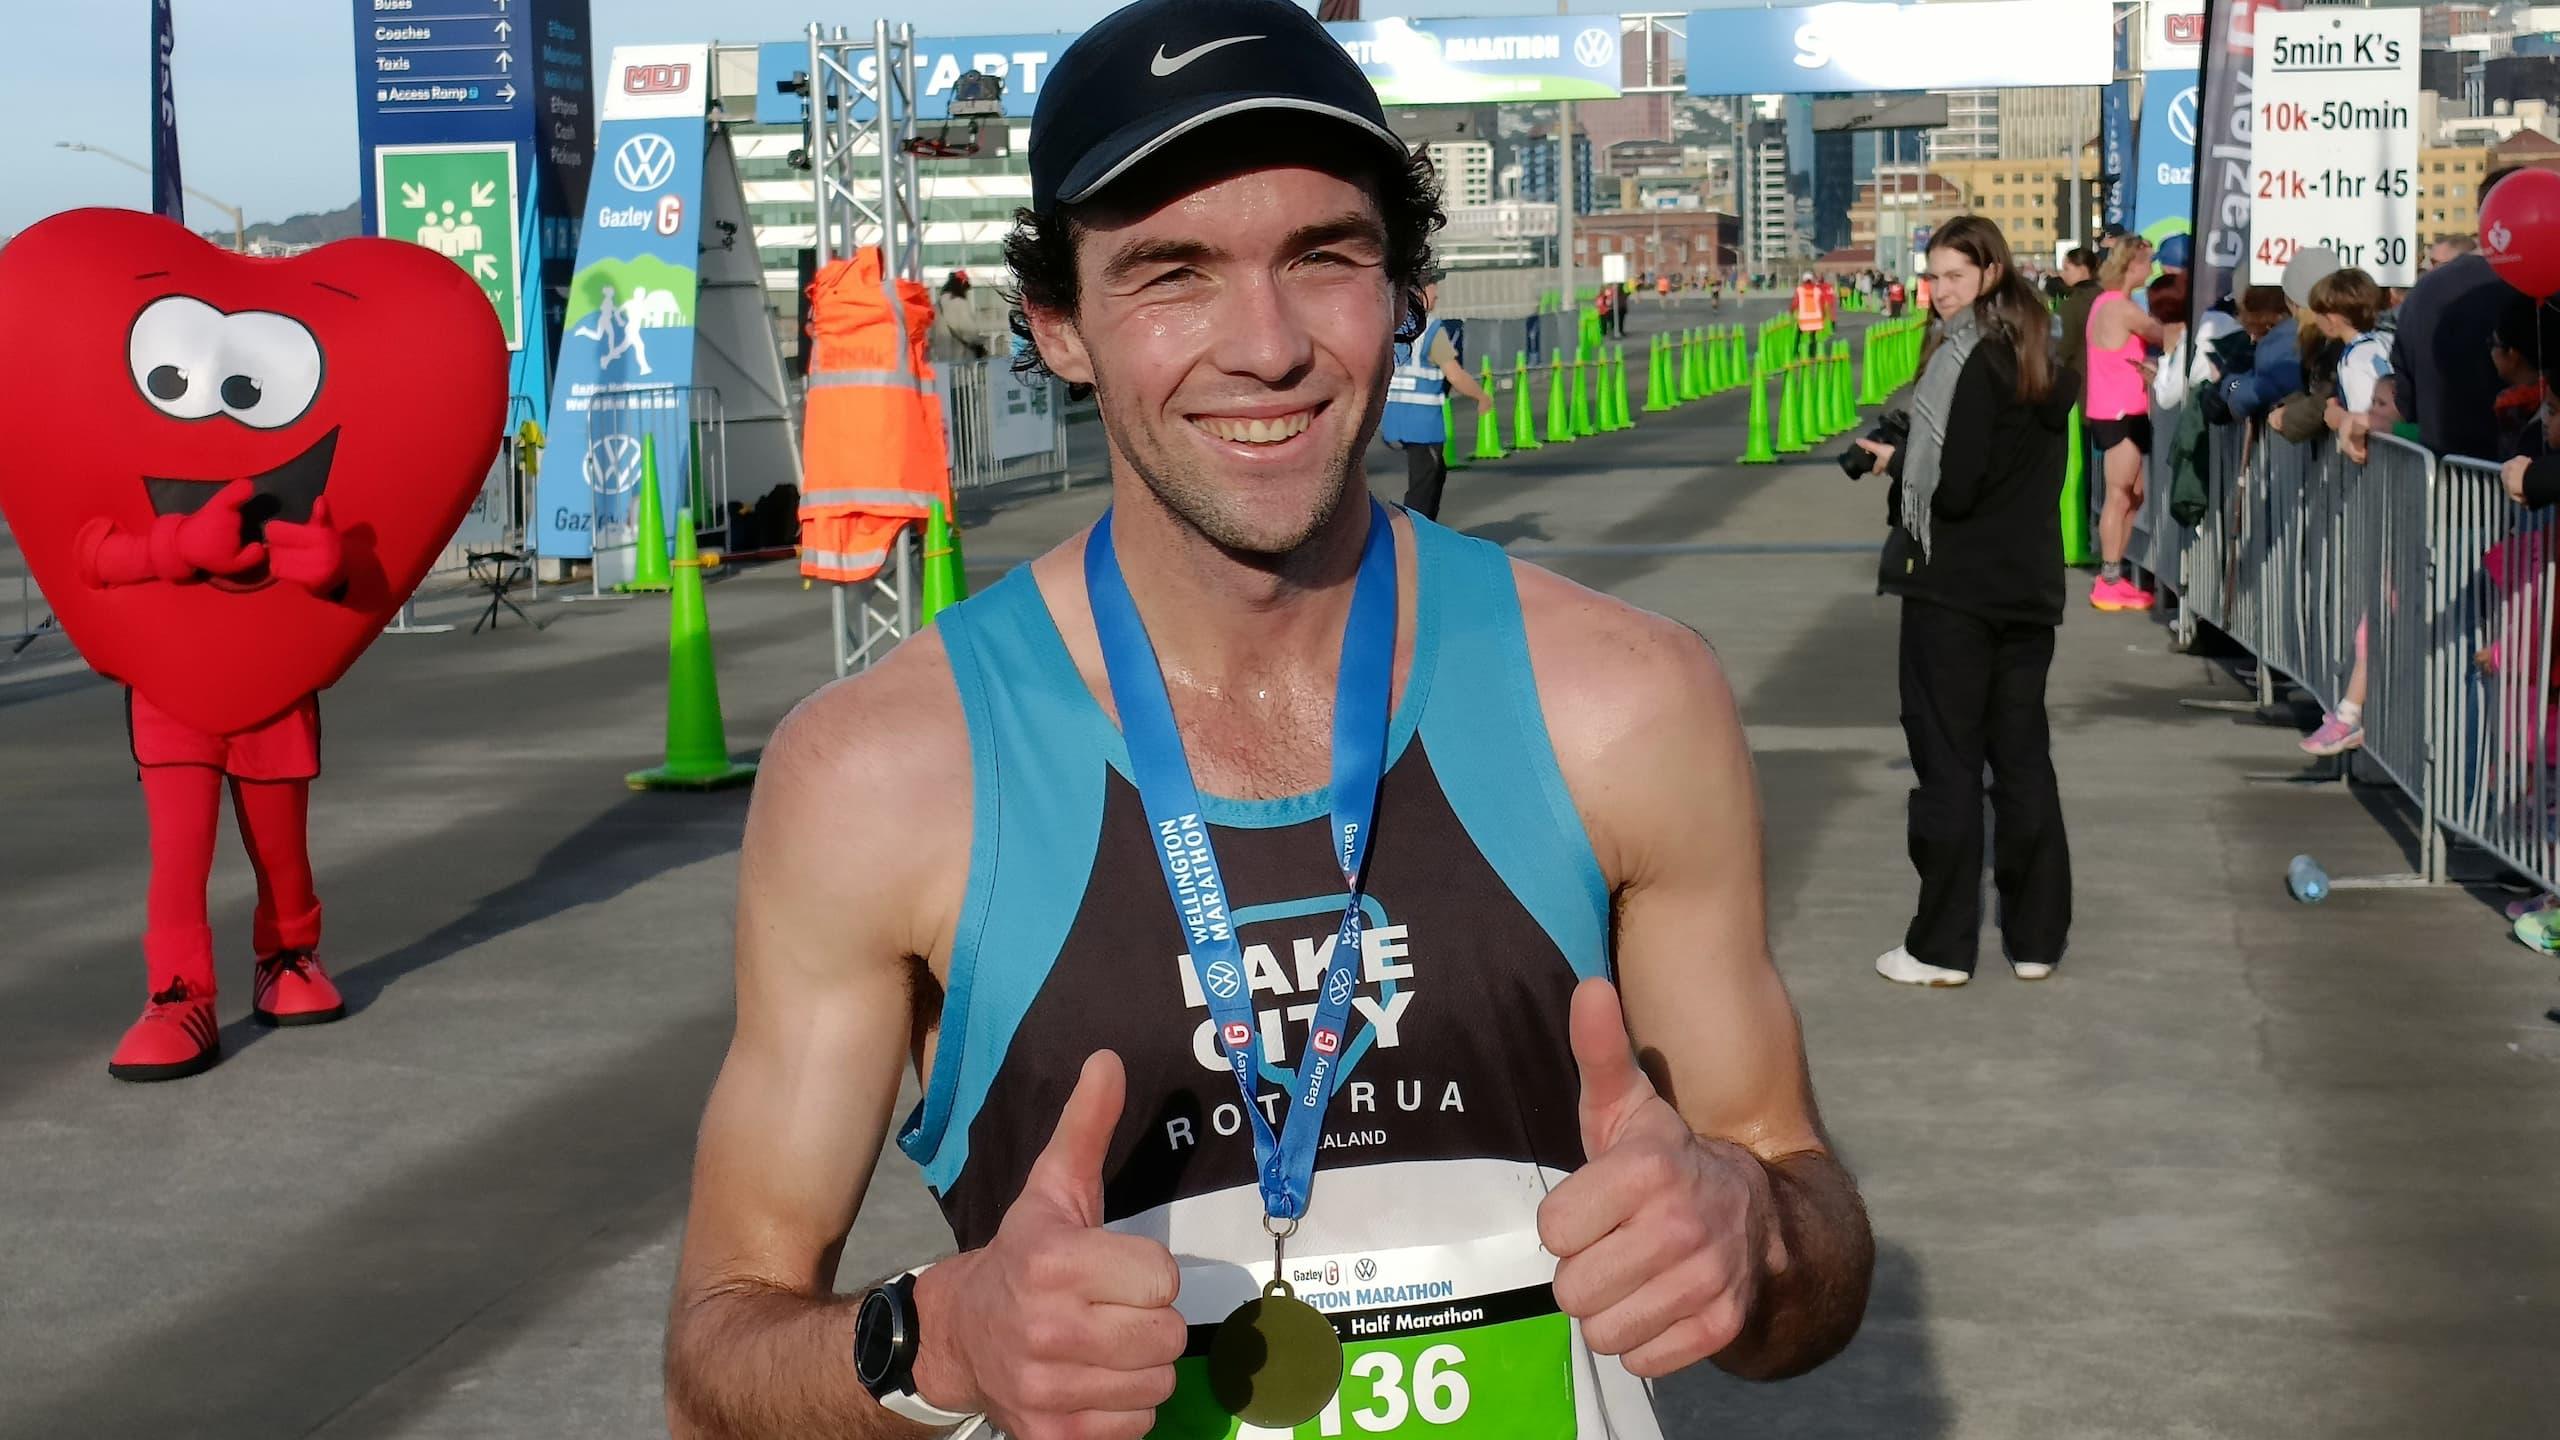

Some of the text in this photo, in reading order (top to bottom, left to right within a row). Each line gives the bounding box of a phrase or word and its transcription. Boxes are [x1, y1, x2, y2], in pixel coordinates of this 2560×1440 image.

[375, 25, 431, 41] Coaches
[2273, 32, 2400, 65] 5min K's
[376, 56, 410, 71] Taxis
[389, 85, 468, 102] Access Ramp
[2262, 100, 2408, 130] 10k-50min
[2157, 163, 2194, 185] Gaz
[2258, 169, 2408, 198] 21k-1hr 45
[599, 206, 653, 231] Gazley
[2374, 237, 2407, 266] 30
[1158, 819, 1209, 945] WELLINGTON
[1179, 813, 1231, 942] MARATHON
[1303, 1056, 1329, 1108] Gazley
[1166, 1079, 1465, 1150] ROTRUA
[1294, 1265, 1323, 1281] Gazley
[1356, 1280, 1453, 1306] MARATHON
[1351, 1315, 1391, 1335] Half
[1396, 1307, 1484, 1331] Marathon
